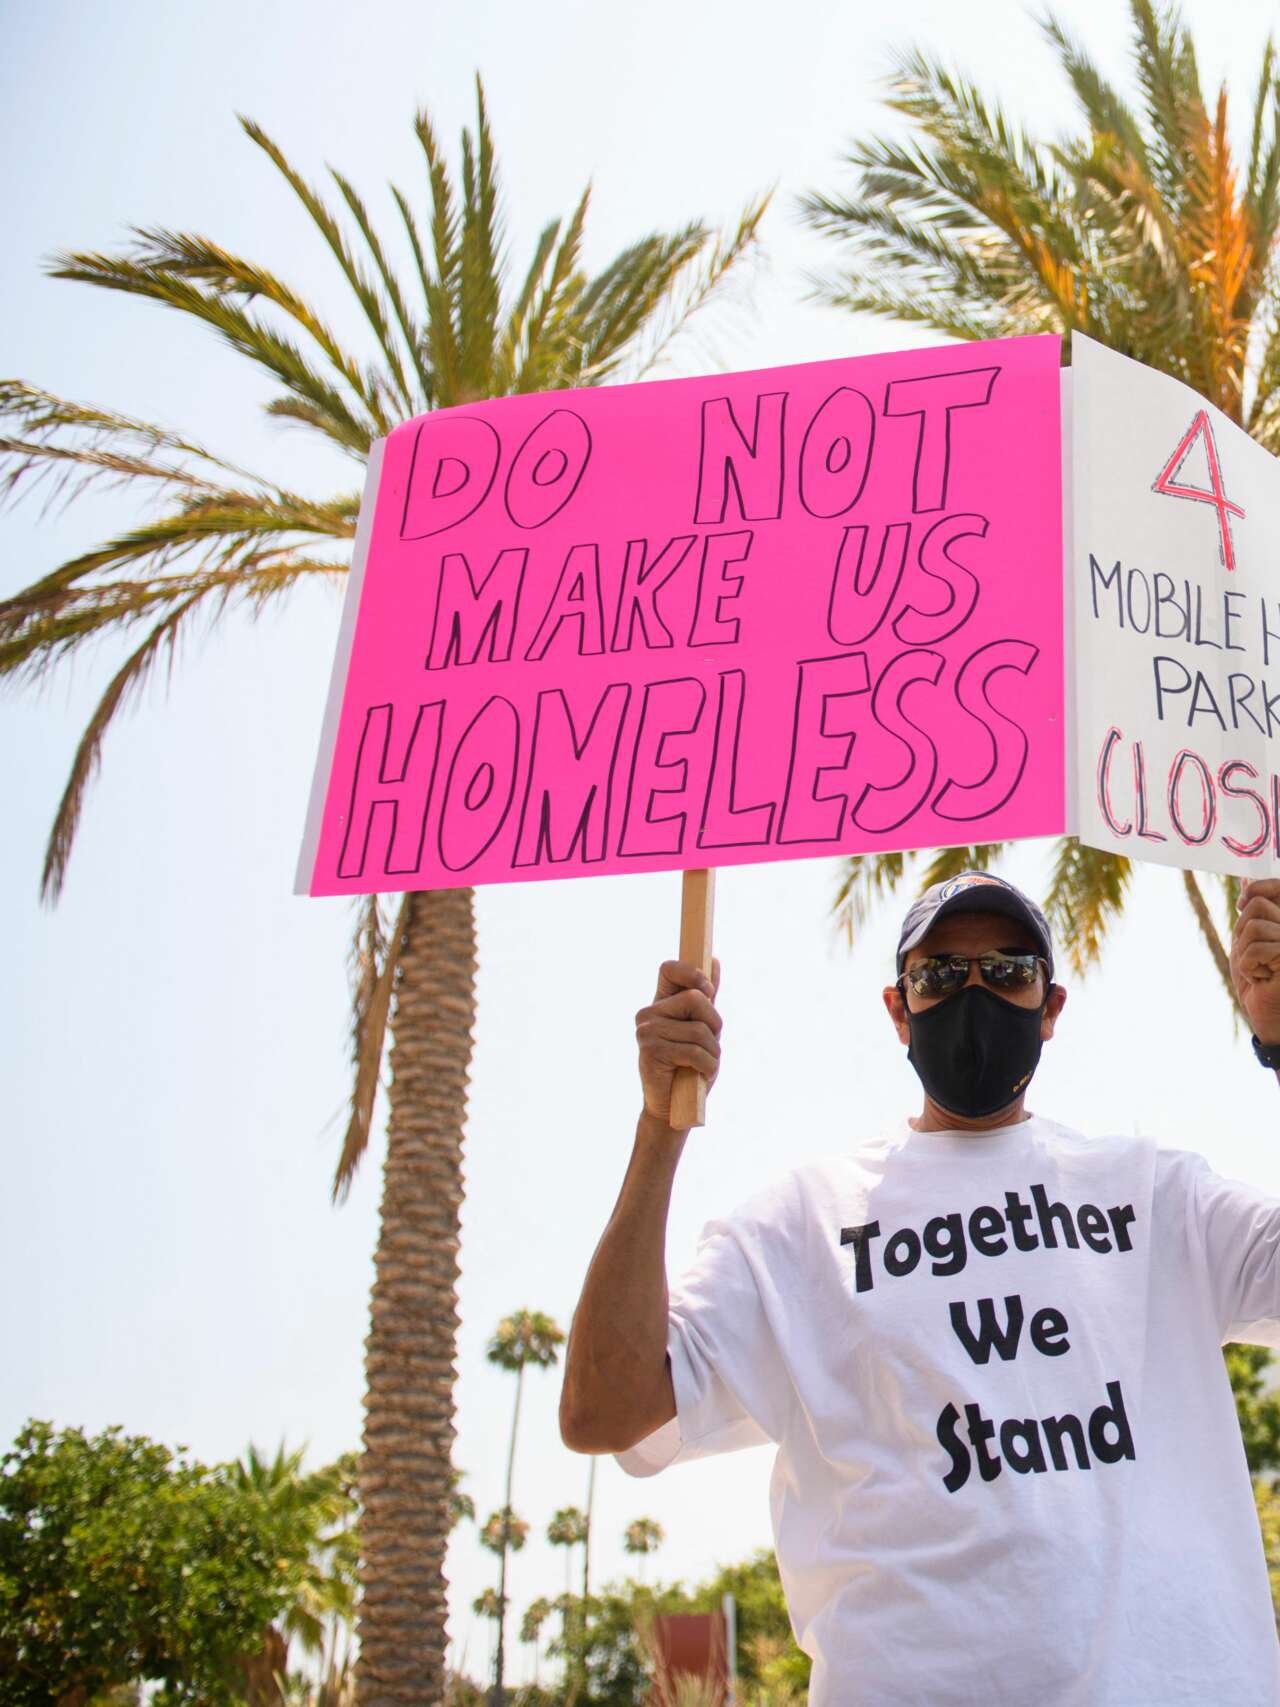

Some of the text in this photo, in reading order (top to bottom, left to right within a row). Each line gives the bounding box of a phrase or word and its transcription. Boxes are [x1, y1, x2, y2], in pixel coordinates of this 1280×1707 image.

[400, 366, 1002, 541] DO NOT
[1151, 409, 1246, 571] 4
[425, 513, 989, 671] MAKE US
[1089, 552, 1247, 652] MOBILE
[337, 639, 1039, 879] HOMELESS
[840, 1184, 1136, 1293] Together
[949, 1294, 1071, 1365] We
[936, 1380, 1136, 1494] Stand
